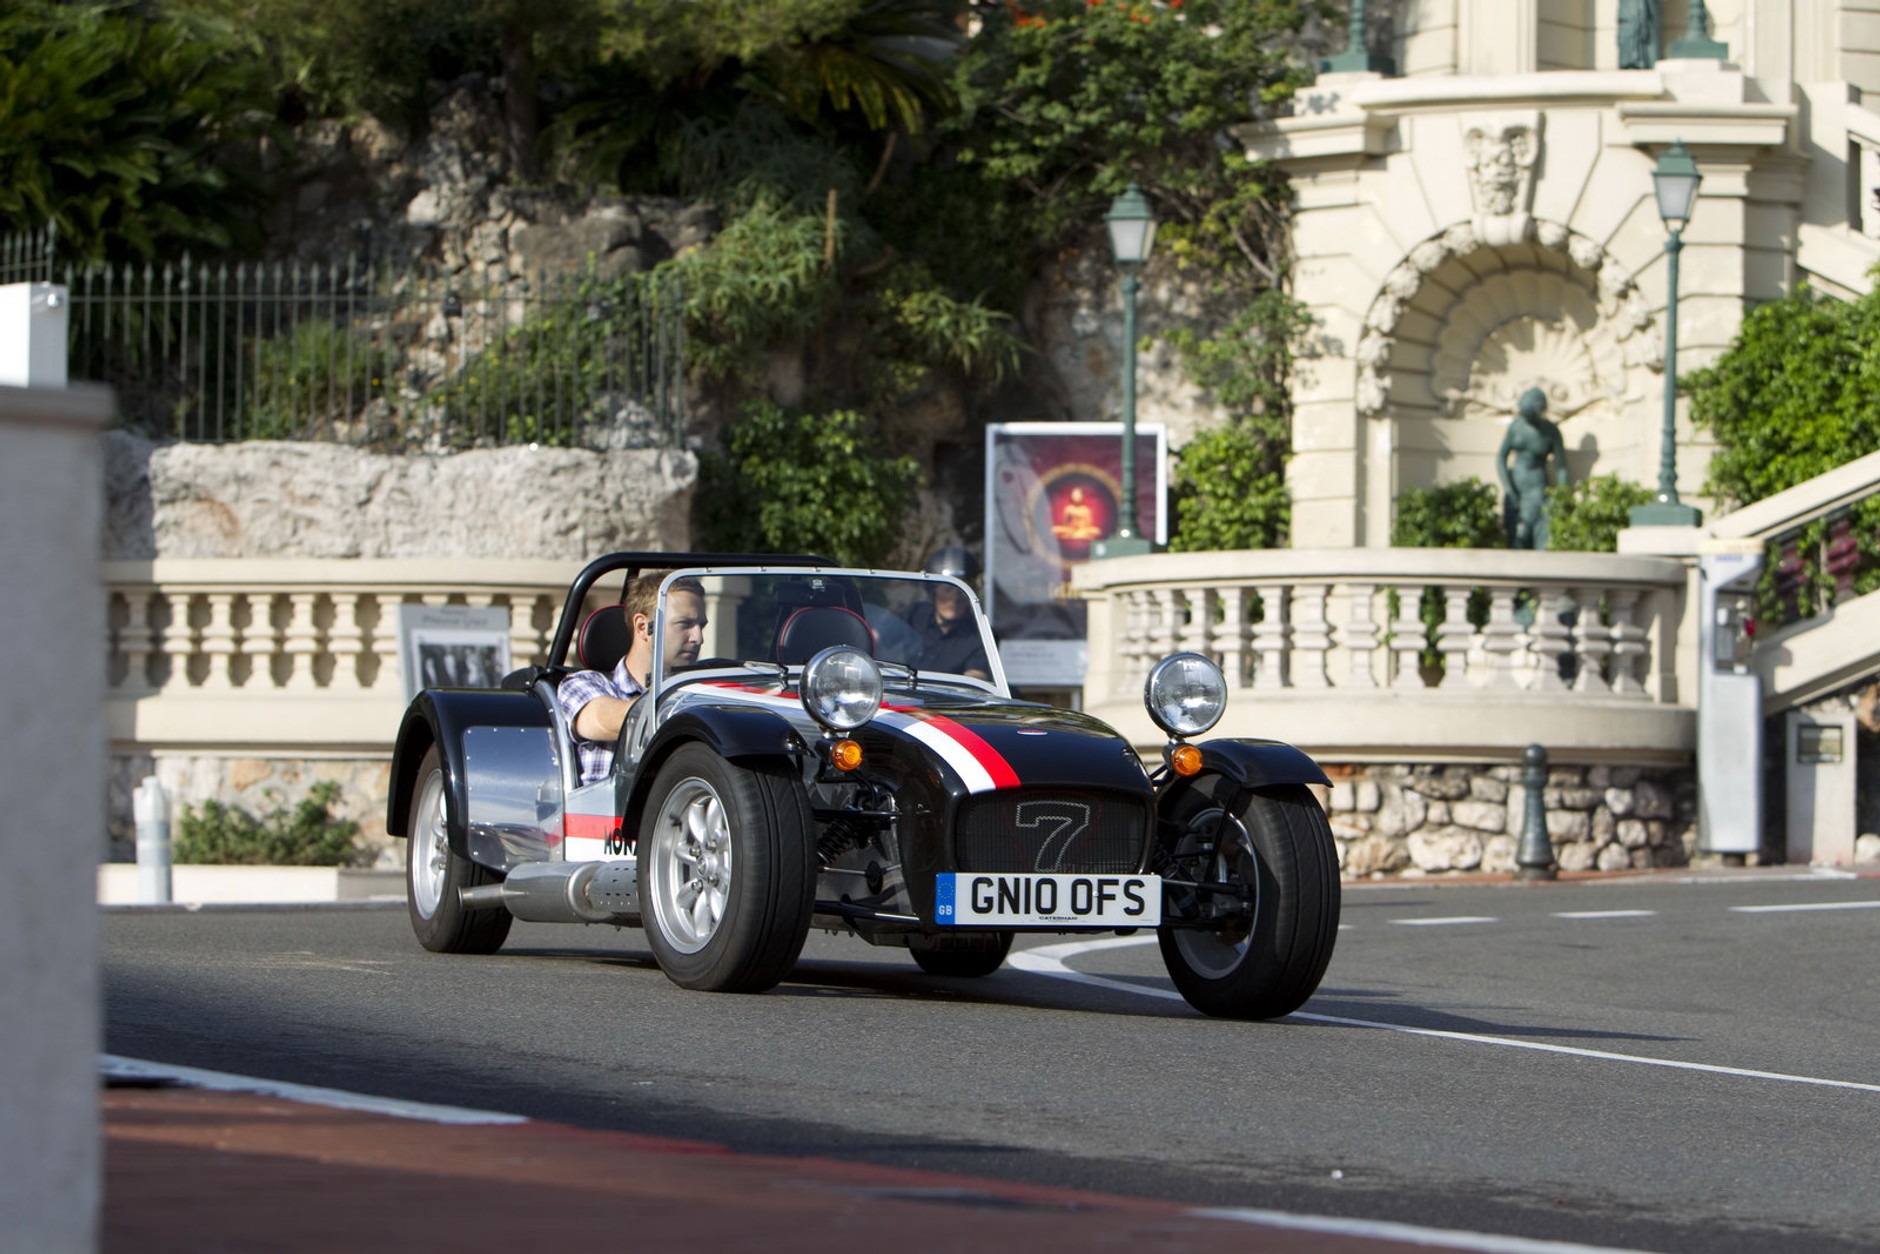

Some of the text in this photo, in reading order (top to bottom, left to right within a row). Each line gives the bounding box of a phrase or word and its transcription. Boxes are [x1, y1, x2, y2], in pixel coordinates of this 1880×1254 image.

[1016, 801, 1091, 873] 7
[938, 904, 953, 916] GB
[971, 877, 1145, 916] GN10 OFS
